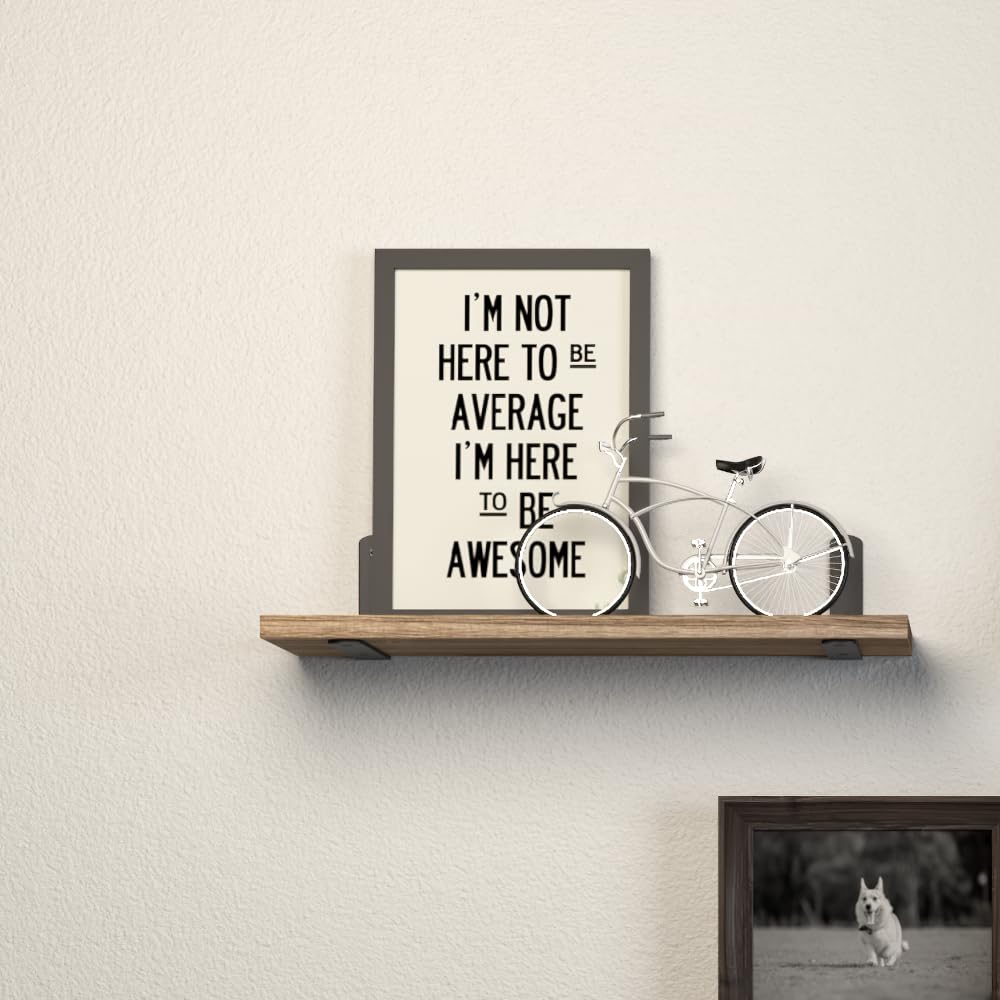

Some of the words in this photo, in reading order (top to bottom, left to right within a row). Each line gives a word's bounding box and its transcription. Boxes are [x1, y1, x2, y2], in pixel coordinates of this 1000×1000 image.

[464, 292, 502, 332] I'M
[515, 294, 572, 332] NOT
[438, 343, 510, 381] HERE
[521, 343, 558, 381] TO
[570, 344, 597, 364] BE
[451, 393, 584, 431] AVERAGE
[455, 441, 494, 480] I'M
[506, 442, 578, 480] HERE
[479, 492, 507, 512] TO
[519, 492, 554, 530] BE
